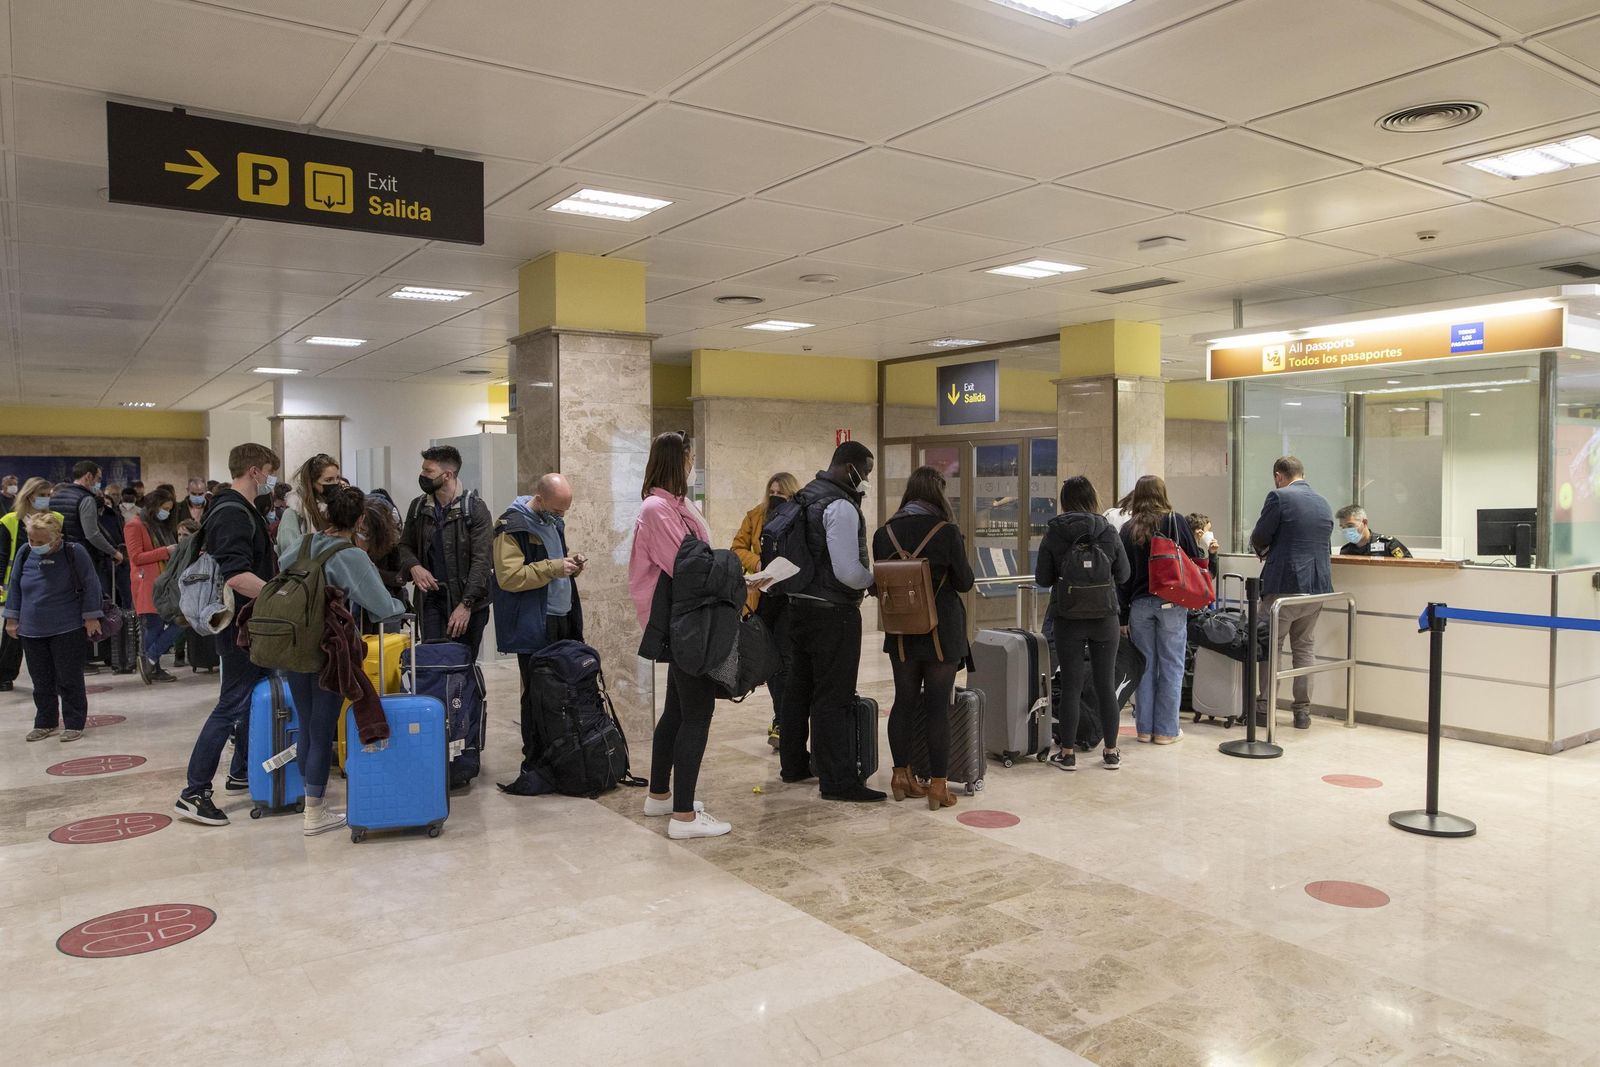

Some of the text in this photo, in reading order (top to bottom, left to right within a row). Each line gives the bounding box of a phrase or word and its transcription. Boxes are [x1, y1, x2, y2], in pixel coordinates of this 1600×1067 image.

[252, 162, 278, 196] P
[368, 172, 398, 193] Exit
[368, 195, 432, 222] Salida
[1289, 338, 1355, 354] All passports
[1289, 347, 1403, 368] Todos los pasaportes
[964, 383, 975, 391] Exit
[964, 392, 986, 403] Salida
